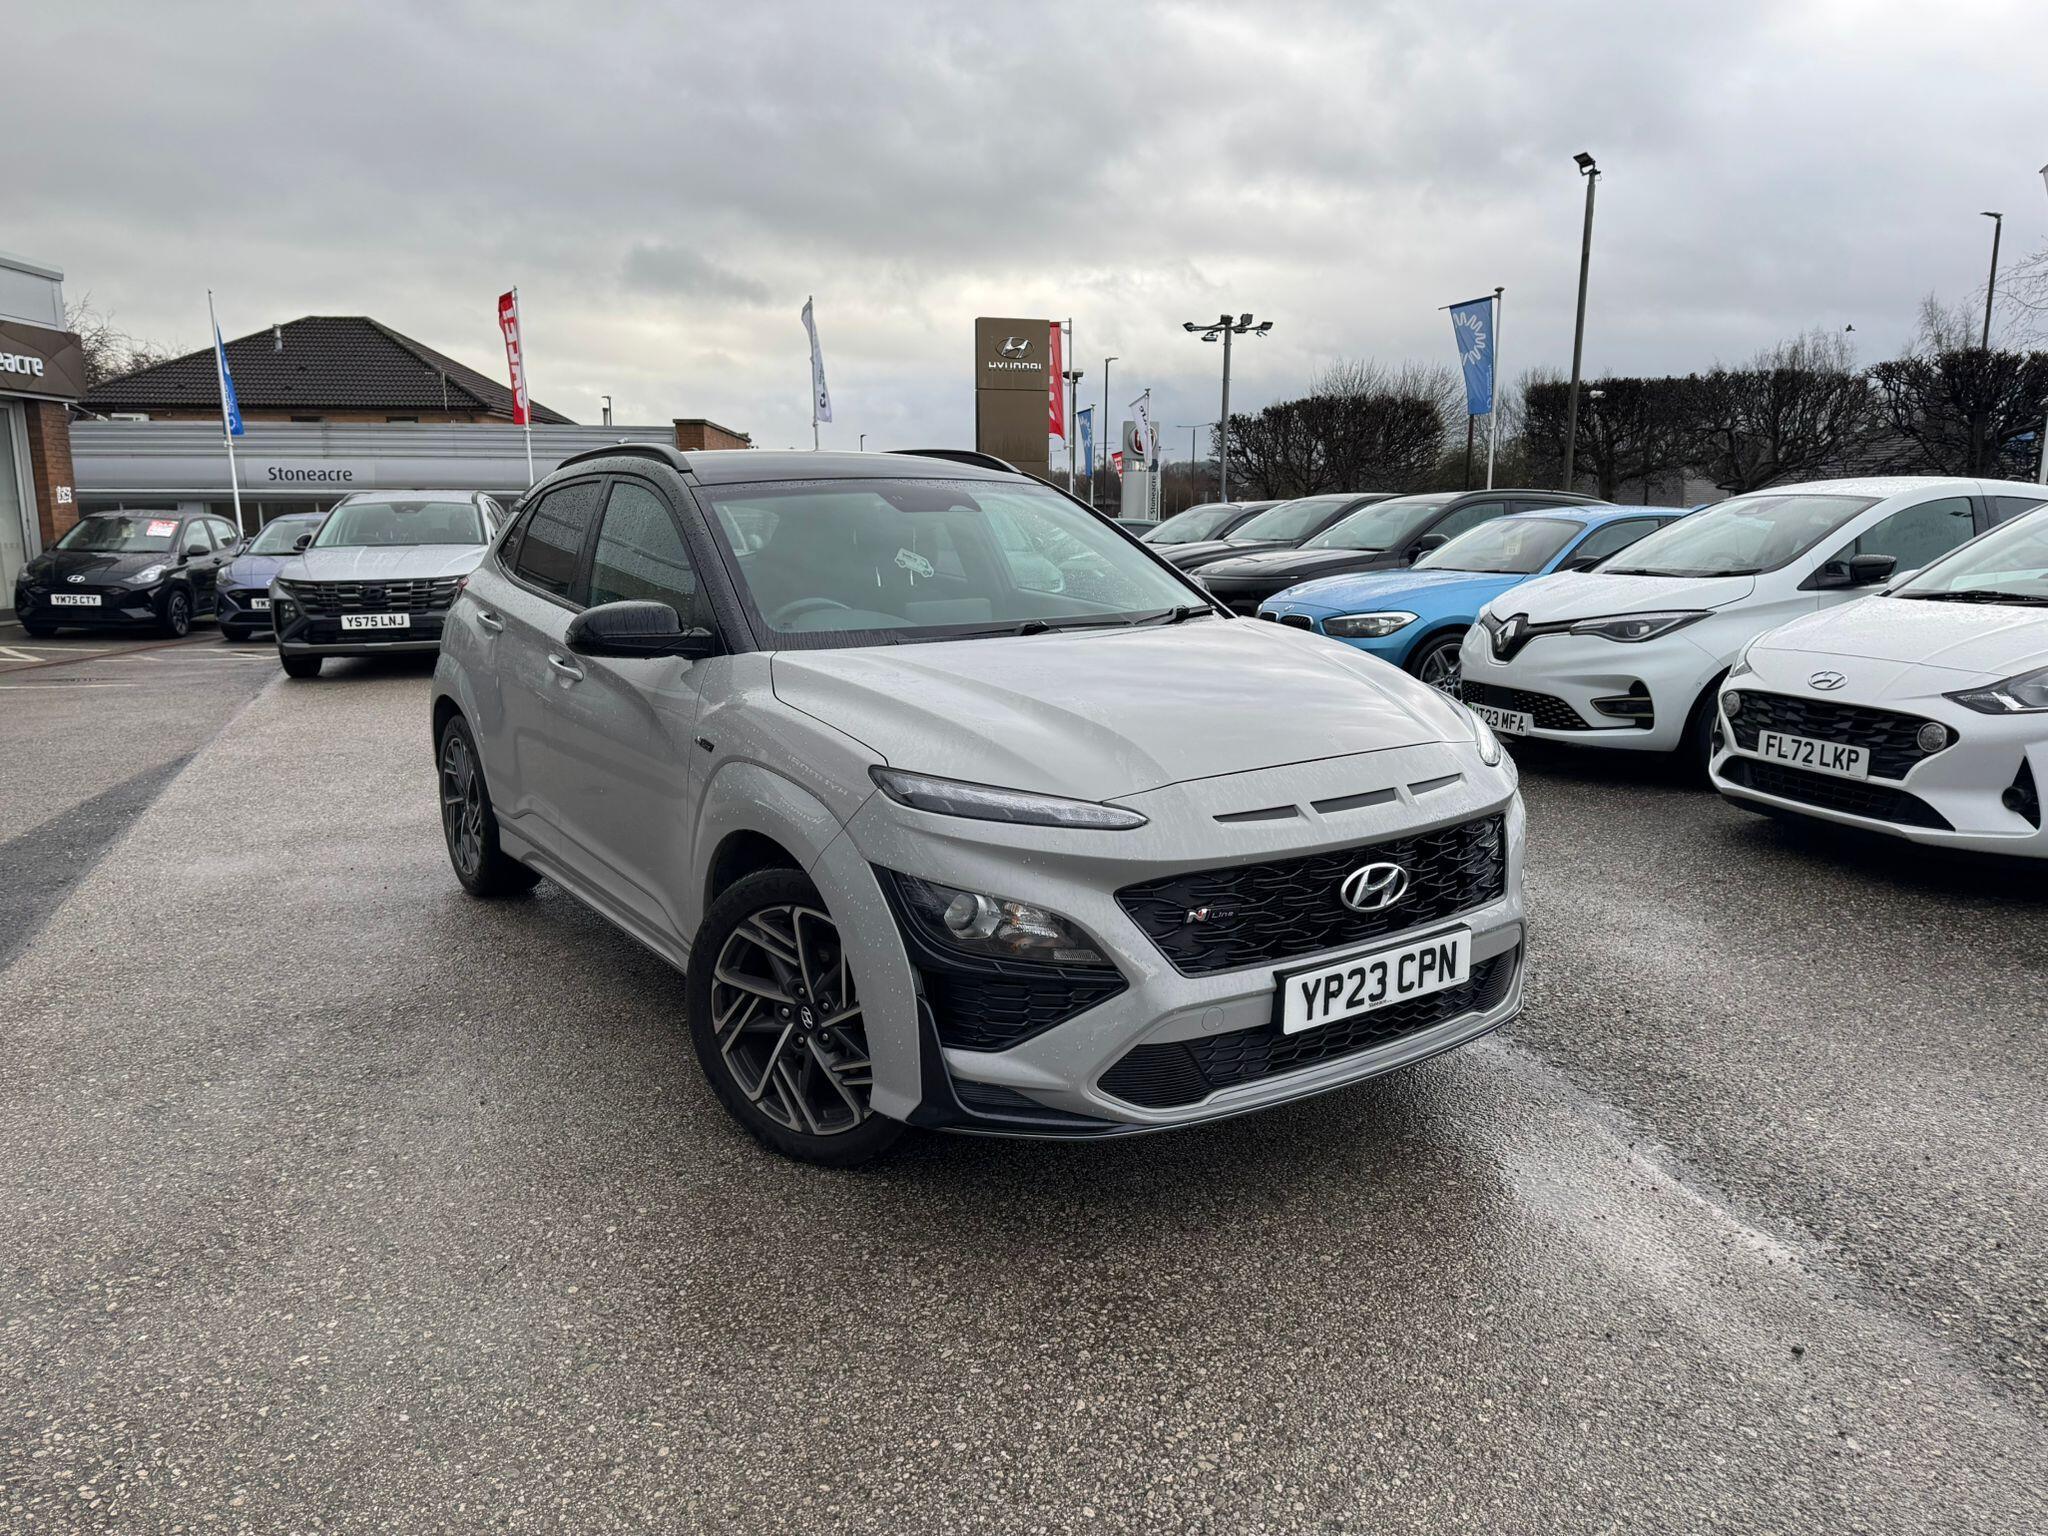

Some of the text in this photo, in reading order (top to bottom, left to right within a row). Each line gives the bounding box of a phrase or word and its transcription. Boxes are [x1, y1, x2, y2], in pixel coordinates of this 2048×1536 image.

[268, 466, 353, 481] Stoneacre
[1150, 475, 1158, 514] Stoneacre
[55, 595, 97, 604] YM75 CTY
[346, 616, 405, 628] YS75 LNJ
[1501, 712, 1524, 732] MFA
[1765, 734, 1860, 771] FL72 LKP
[1301, 940, 1457, 1021] YP23 CPN
